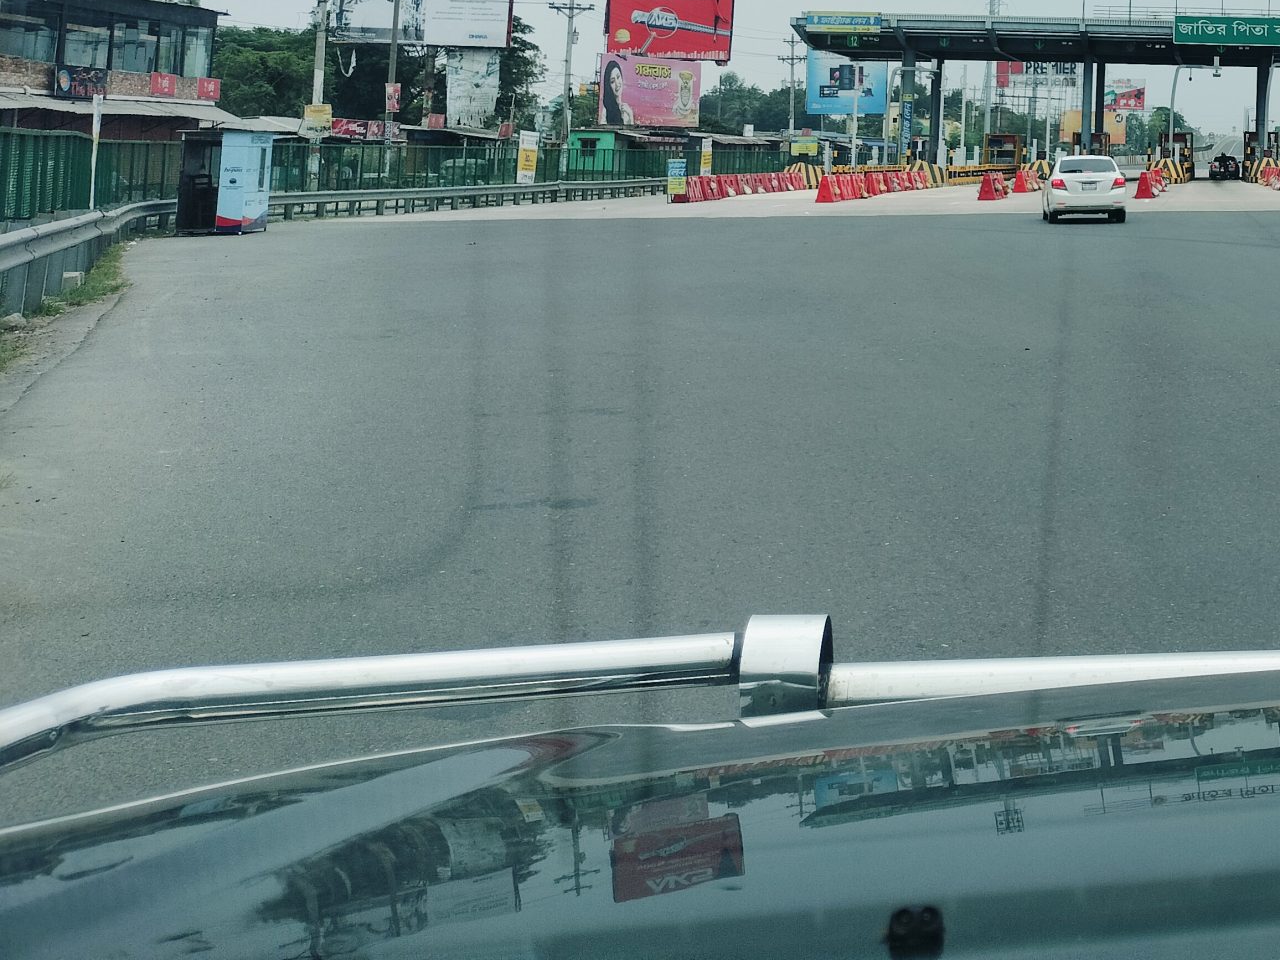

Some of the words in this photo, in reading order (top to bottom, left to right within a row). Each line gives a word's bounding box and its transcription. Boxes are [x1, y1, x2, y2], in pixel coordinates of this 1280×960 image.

[1177, 20, 1227, 36] জাতির
[1232, 21, 1269, 37] পিতা
[850, 35, 858, 47] 12
